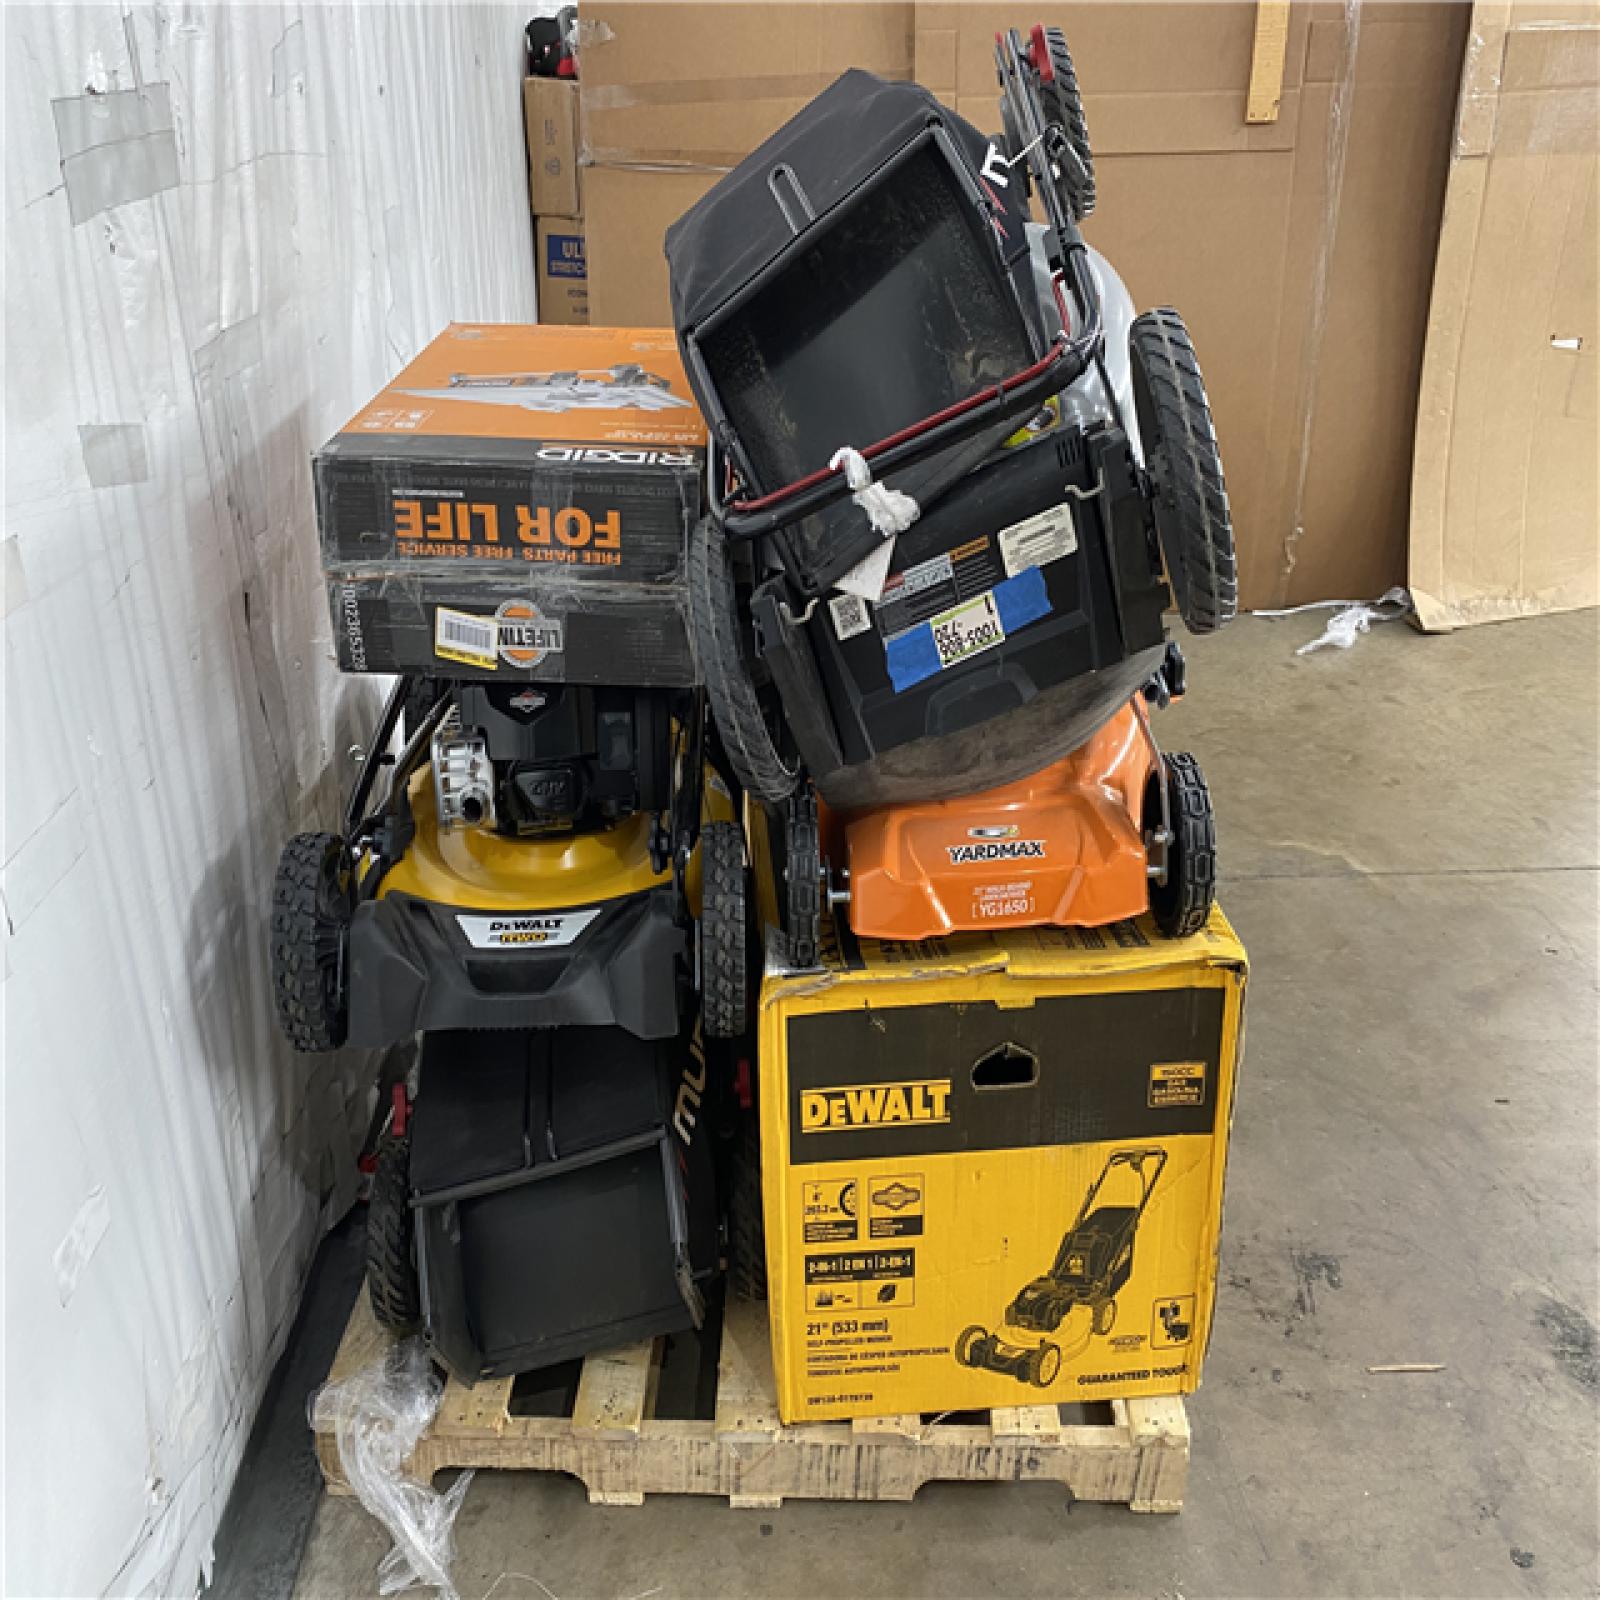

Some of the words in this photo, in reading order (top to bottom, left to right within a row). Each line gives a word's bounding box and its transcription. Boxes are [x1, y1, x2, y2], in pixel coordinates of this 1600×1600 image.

[536, 448, 695, 466] RIDGID
[393, 499, 498, 543] LIFE
[515, 504, 621, 549] FOR
[396, 542, 469, 558] SERVICE
[473, 544, 513, 561] FREE
[522, 546, 577, 564] PARTS
[583, 551, 621, 566] FREE
[946, 840, 1046, 864] YARDMAX
[802, 1082, 951, 1130] DEWALT
[1077, 1368, 1151, 1386] GUARANTEED
